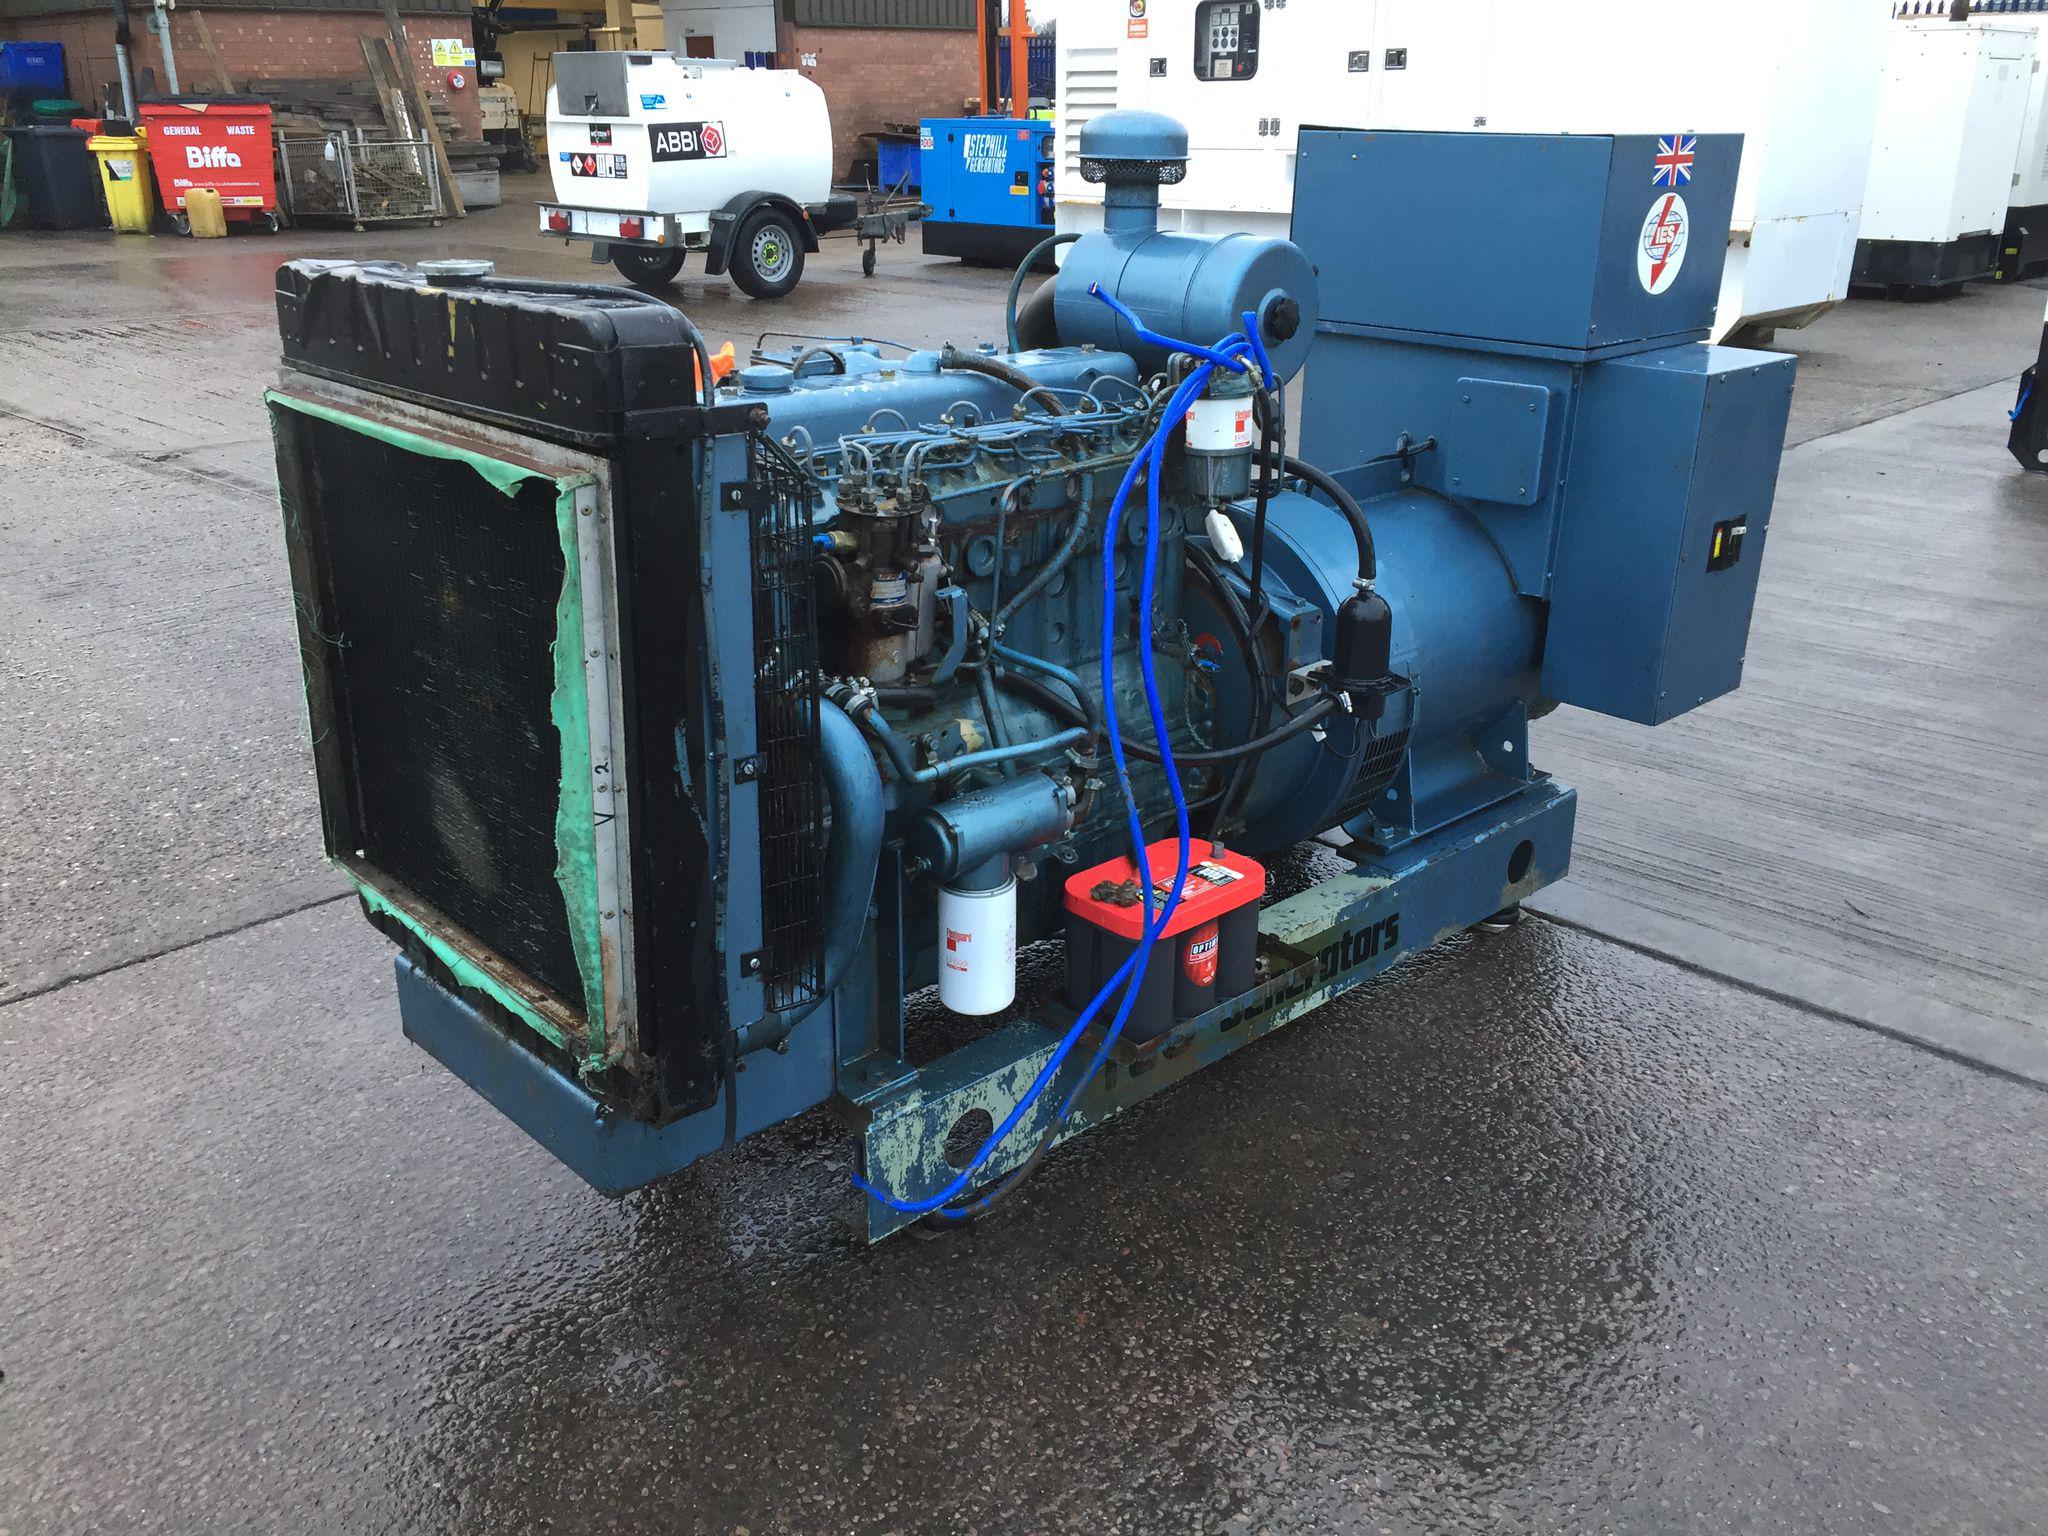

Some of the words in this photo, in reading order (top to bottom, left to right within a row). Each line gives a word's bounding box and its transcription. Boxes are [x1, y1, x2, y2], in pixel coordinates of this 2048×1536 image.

[163, 126, 201, 136] GENERAL
[226, 125, 256, 135] WASTE
[656, 130, 699, 154] ABBI
[969, 134, 1007, 158] STEPHILL
[185, 145, 242, 169] Biffa
[970, 157, 1006, 173] GENERATORS
[1655, 225, 1676, 244] IES
